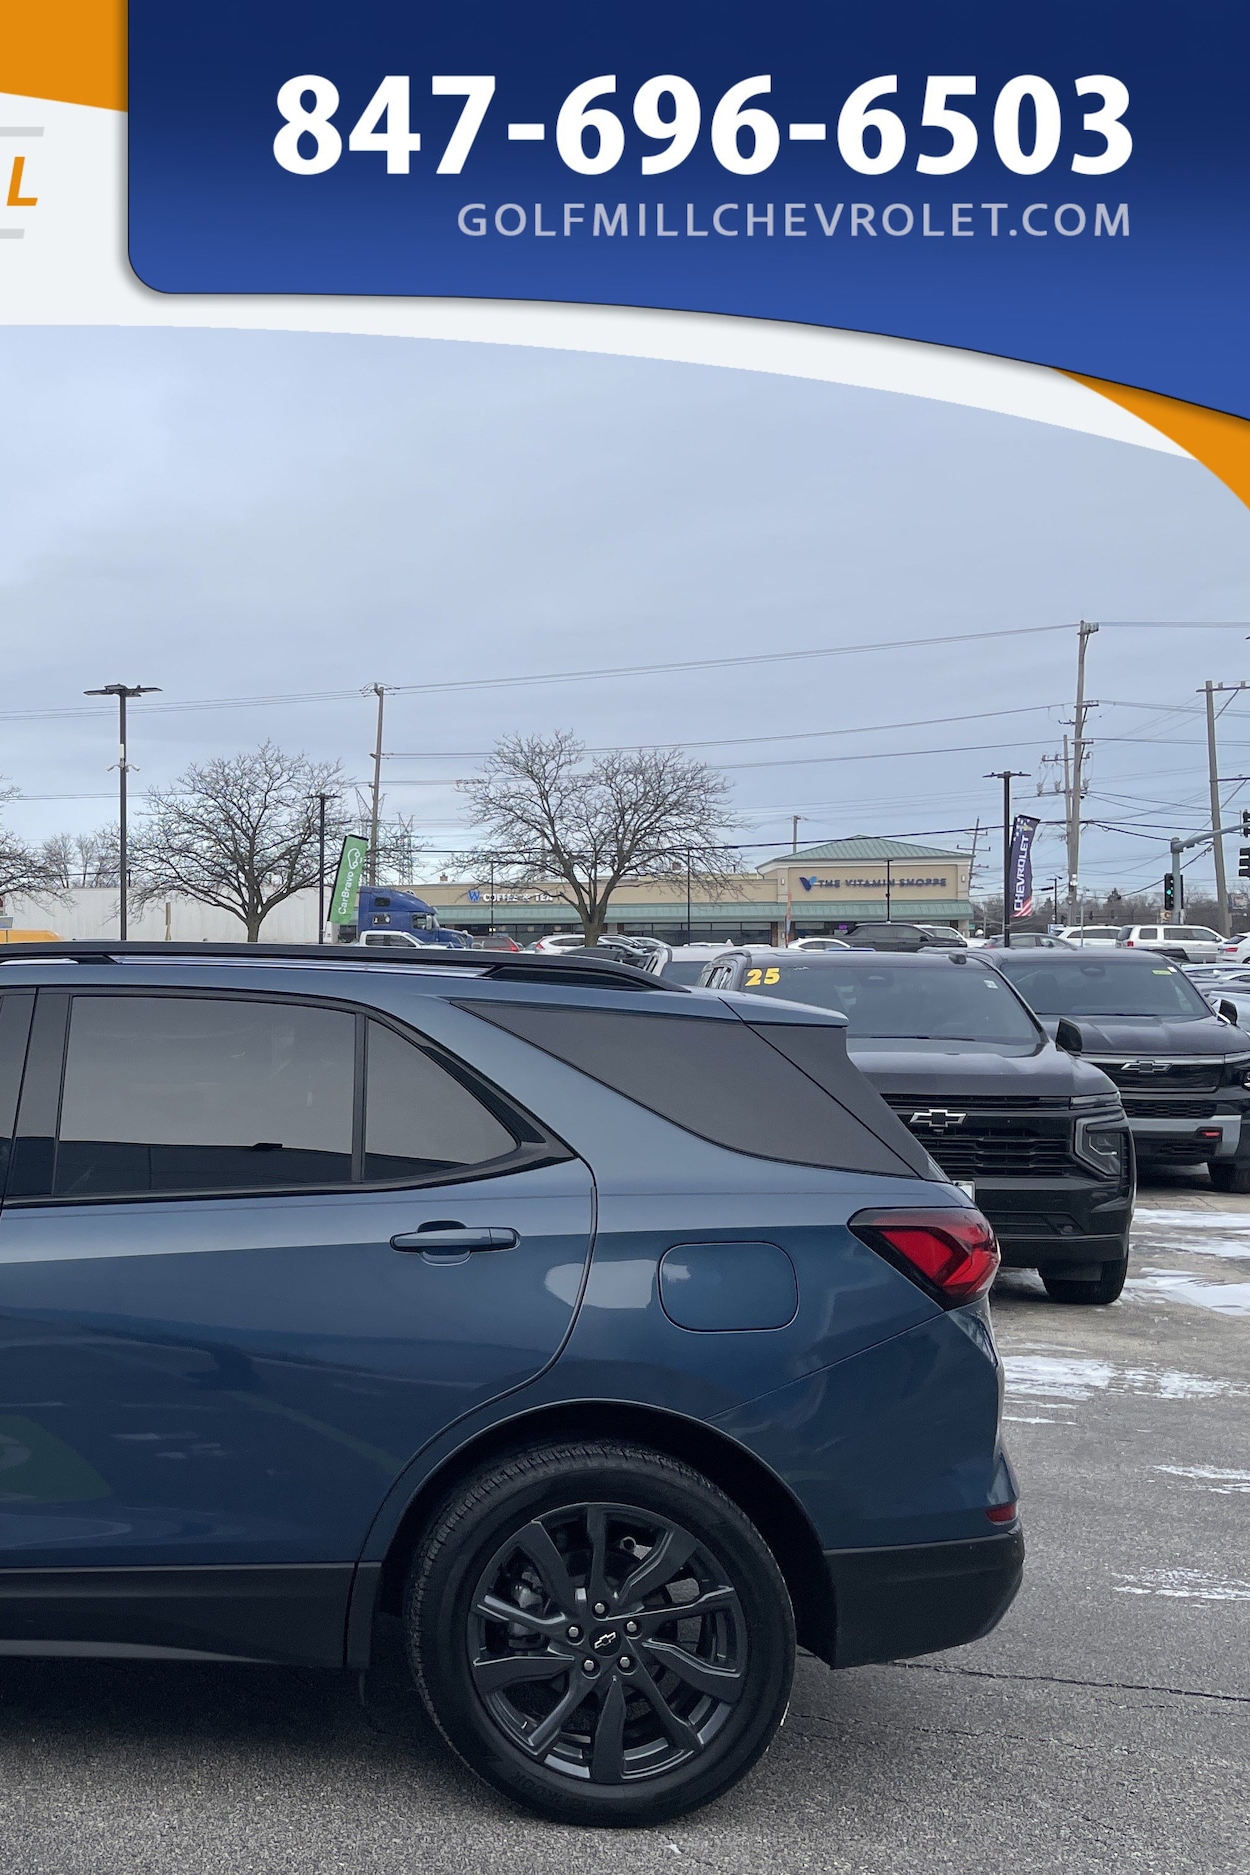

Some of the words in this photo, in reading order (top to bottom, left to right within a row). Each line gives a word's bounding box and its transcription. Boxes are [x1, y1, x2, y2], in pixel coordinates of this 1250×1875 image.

[818, 879, 840, 888] THE
[845, 879, 895, 887] VITAMIN
[899, 878, 947, 887] SHOPPE
[1014, 834, 1030, 911] CHEVROLET
[338, 871, 354, 915] CarBravo
[744, 968, 780, 987] 25
